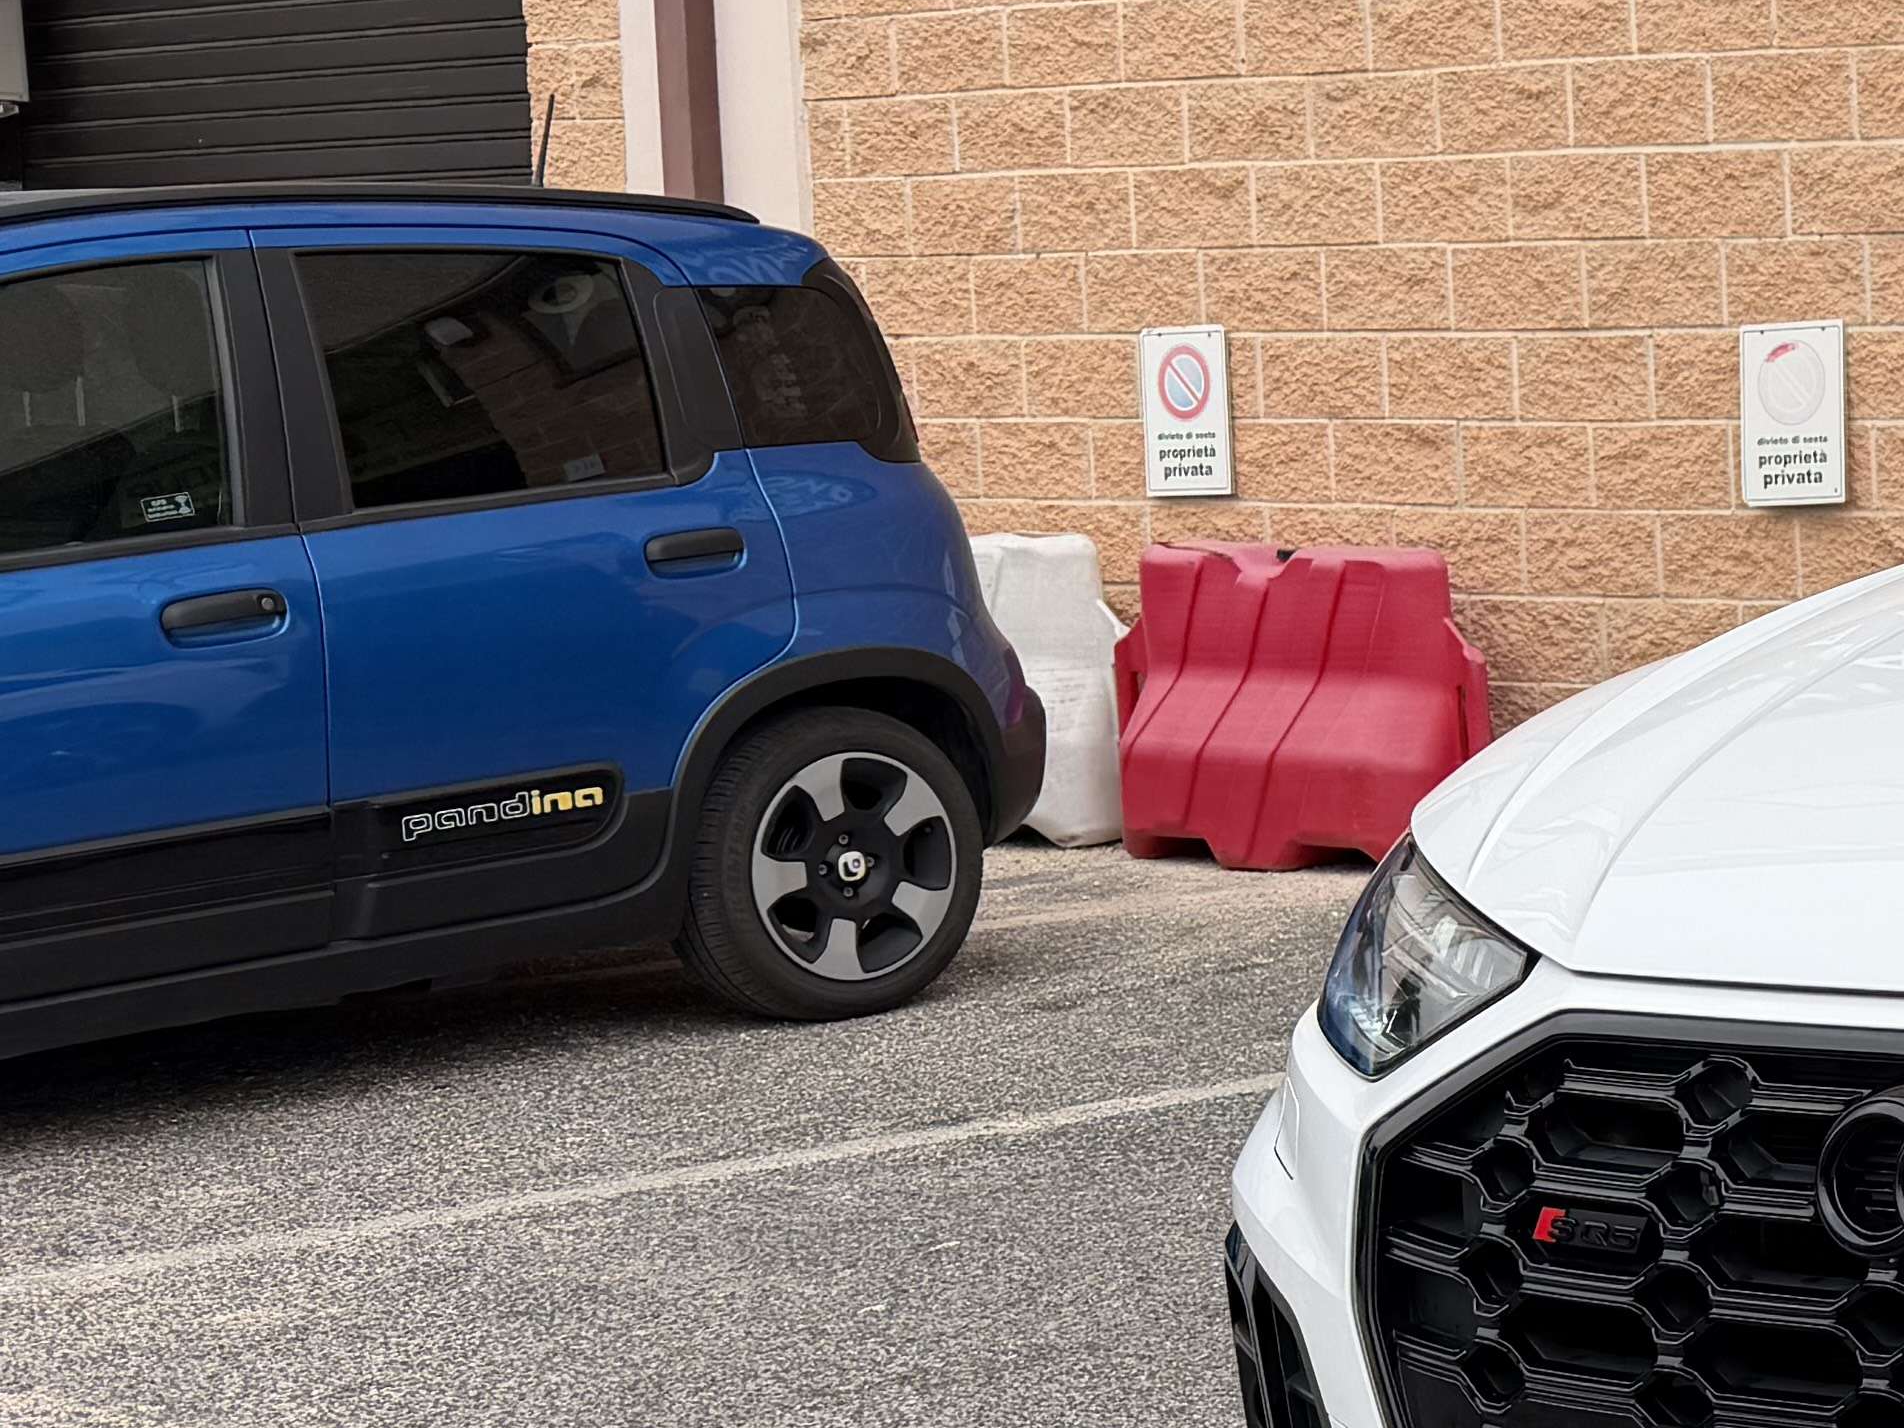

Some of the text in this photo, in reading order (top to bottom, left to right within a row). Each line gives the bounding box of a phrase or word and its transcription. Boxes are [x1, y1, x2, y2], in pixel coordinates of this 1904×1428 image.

[1757, 436, 1789, 446] divieto
[1791, 434, 1800, 445] di
[1159, 443, 1217, 462] proprietà
[1758, 449, 1828, 469] proprietà
[1164, 462, 1213, 481] privata
[1763, 469, 1823, 489] privata
[401, 786, 604, 842] pandina
